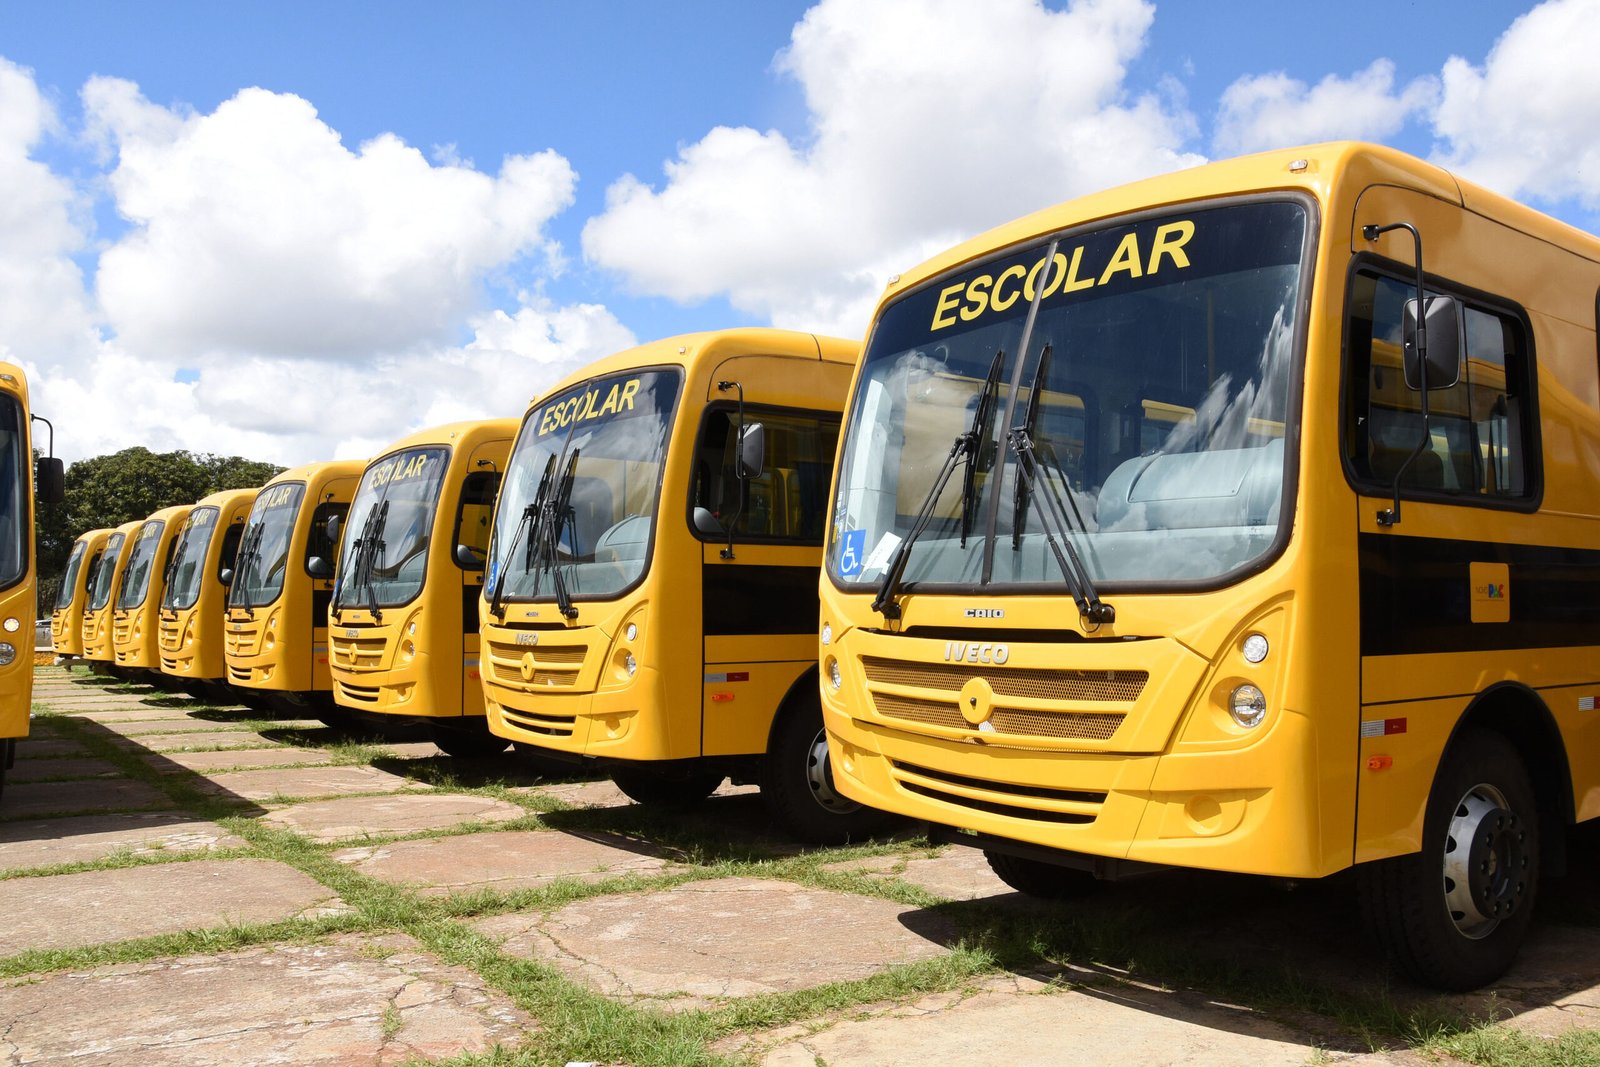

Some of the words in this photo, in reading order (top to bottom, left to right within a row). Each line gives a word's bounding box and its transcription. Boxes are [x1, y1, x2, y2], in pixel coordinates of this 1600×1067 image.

[931, 219, 1195, 331] ESCOLAR
[538, 379, 641, 437] ESCOLAR
[963, 608, 1004, 618] CAIO
[944, 641, 1009, 665] IVECO
